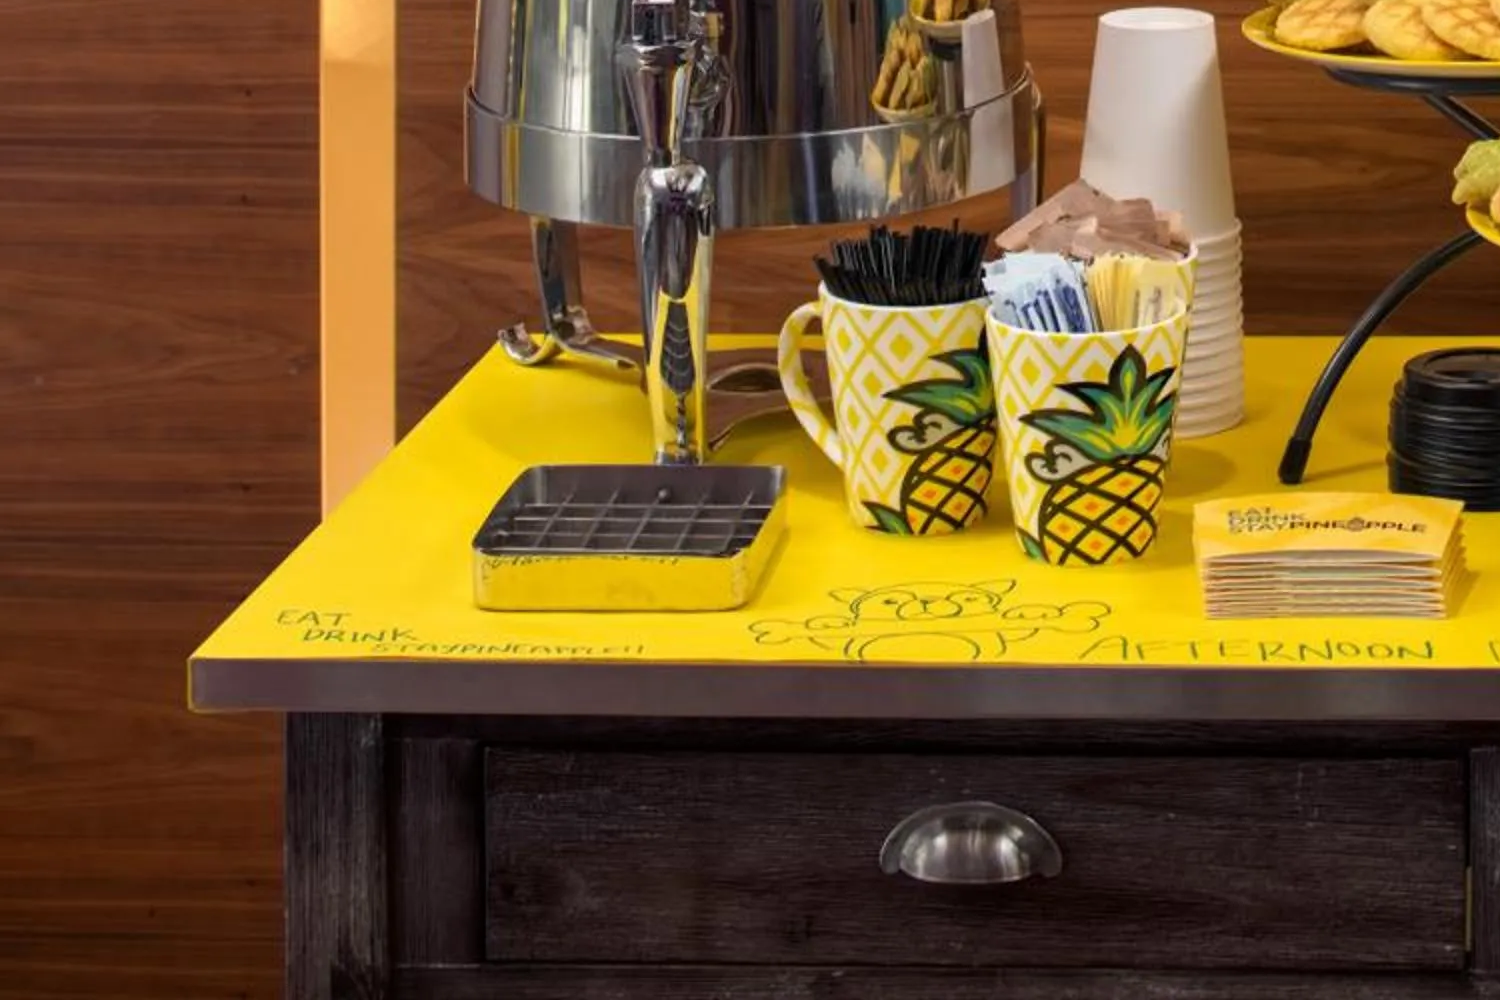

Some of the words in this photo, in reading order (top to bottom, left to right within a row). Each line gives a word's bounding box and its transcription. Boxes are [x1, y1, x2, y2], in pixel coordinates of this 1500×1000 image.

[277, 609, 351, 626] EAT
[302, 627, 418, 642] DRINK
[1078, 634, 1434, 662] AFTERNOON
